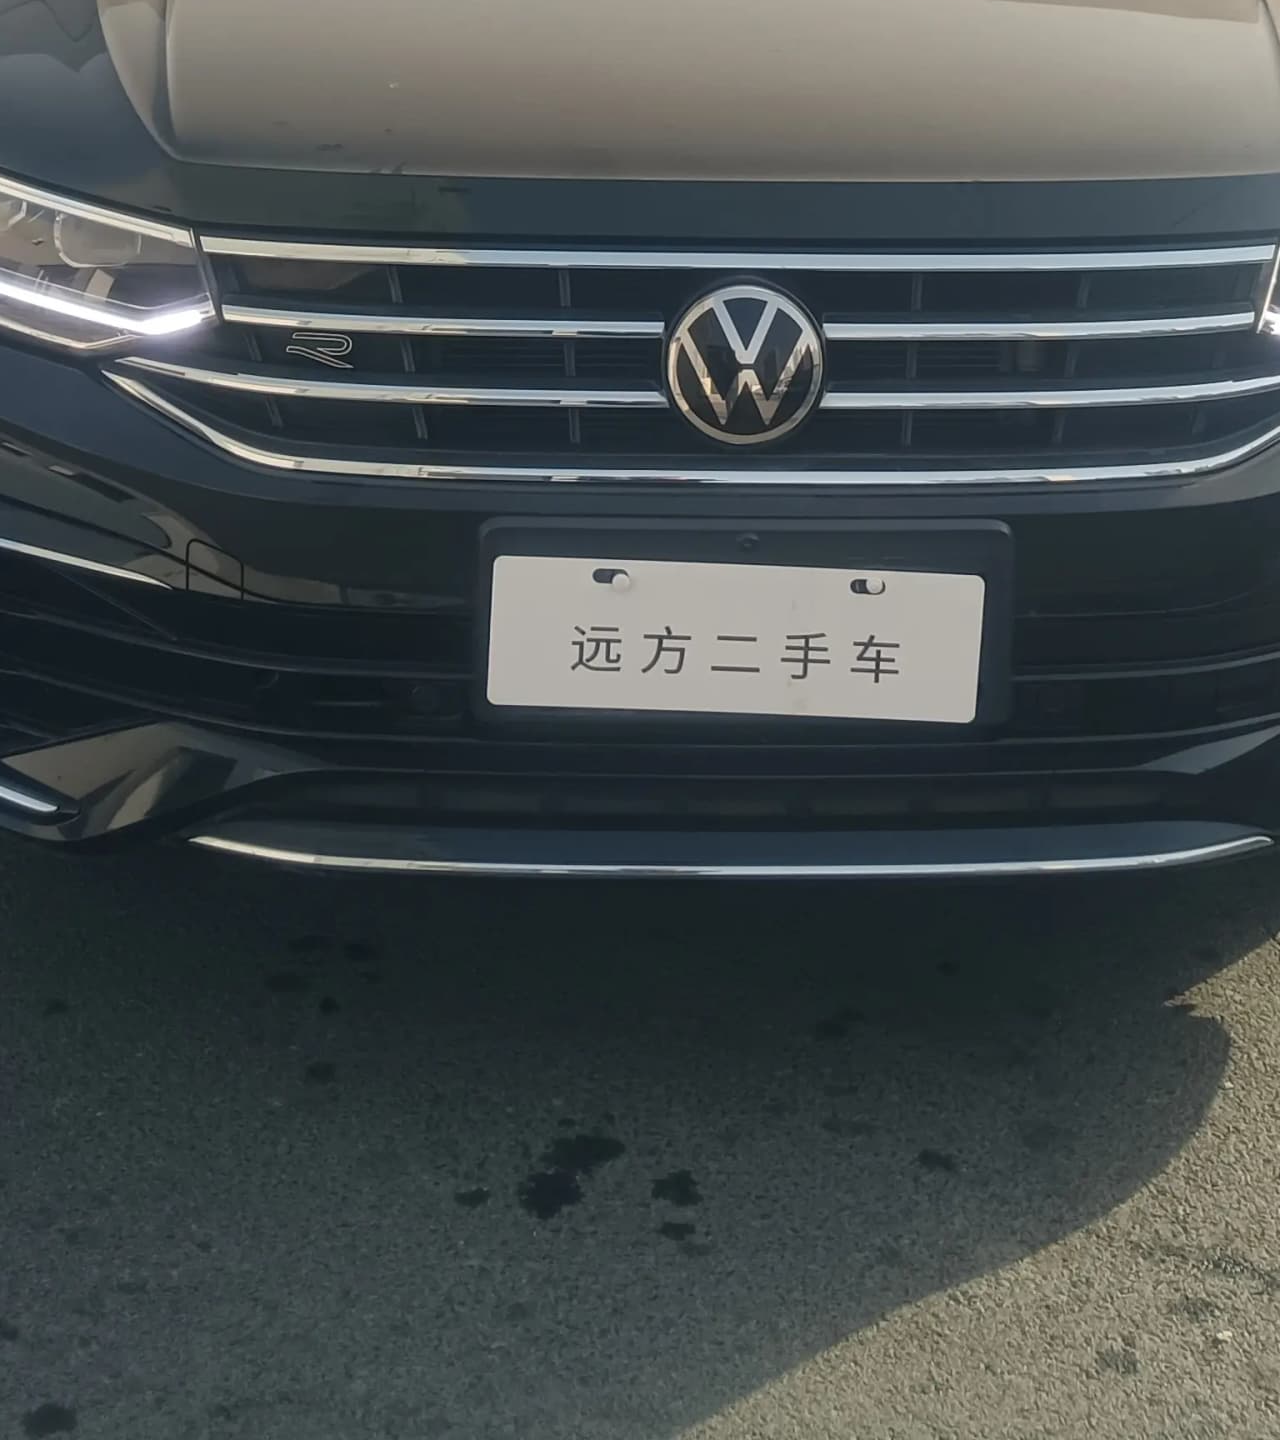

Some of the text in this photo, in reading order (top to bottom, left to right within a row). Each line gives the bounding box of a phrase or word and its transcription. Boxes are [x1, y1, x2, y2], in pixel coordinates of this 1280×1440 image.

[570, 625, 901, 684] 远方二手车
